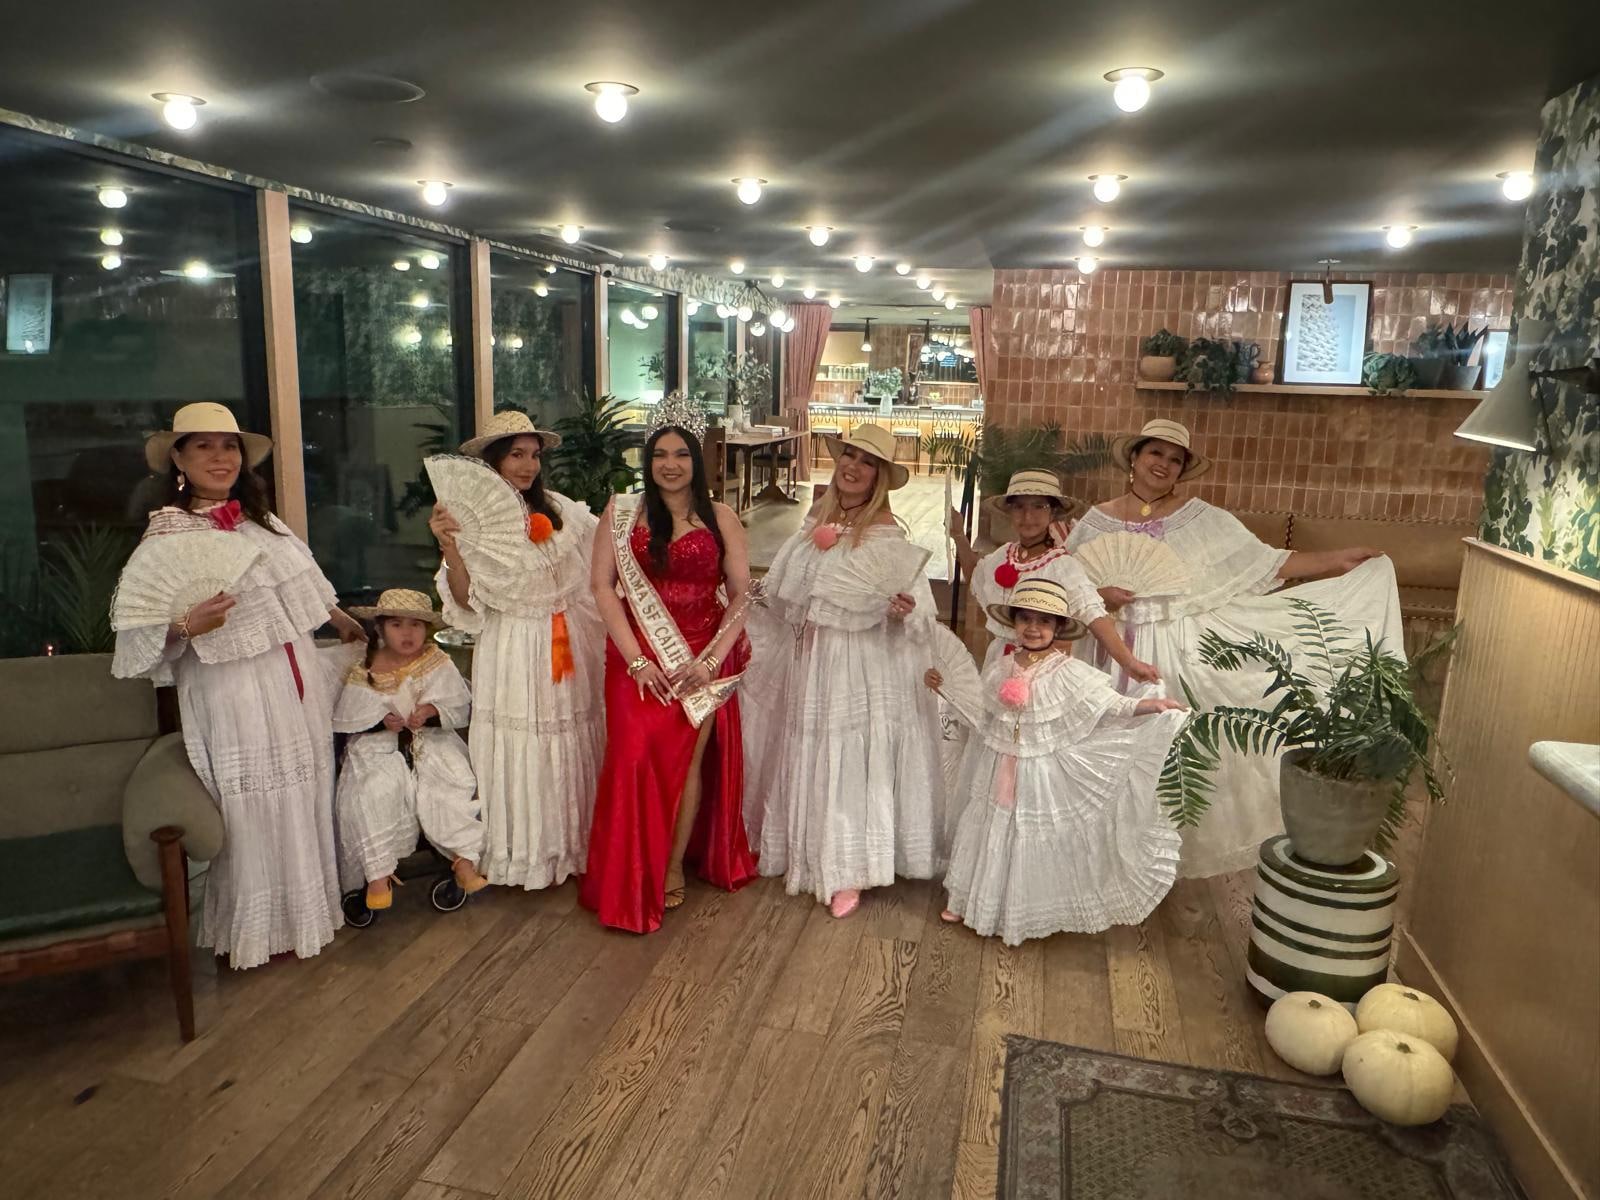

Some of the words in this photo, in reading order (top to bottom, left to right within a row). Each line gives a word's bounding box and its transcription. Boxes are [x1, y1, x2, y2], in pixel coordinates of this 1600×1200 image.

[616, 509, 631, 540] MISS
[619, 545, 648, 602] PANAMA
[642, 605, 661, 621] SF
